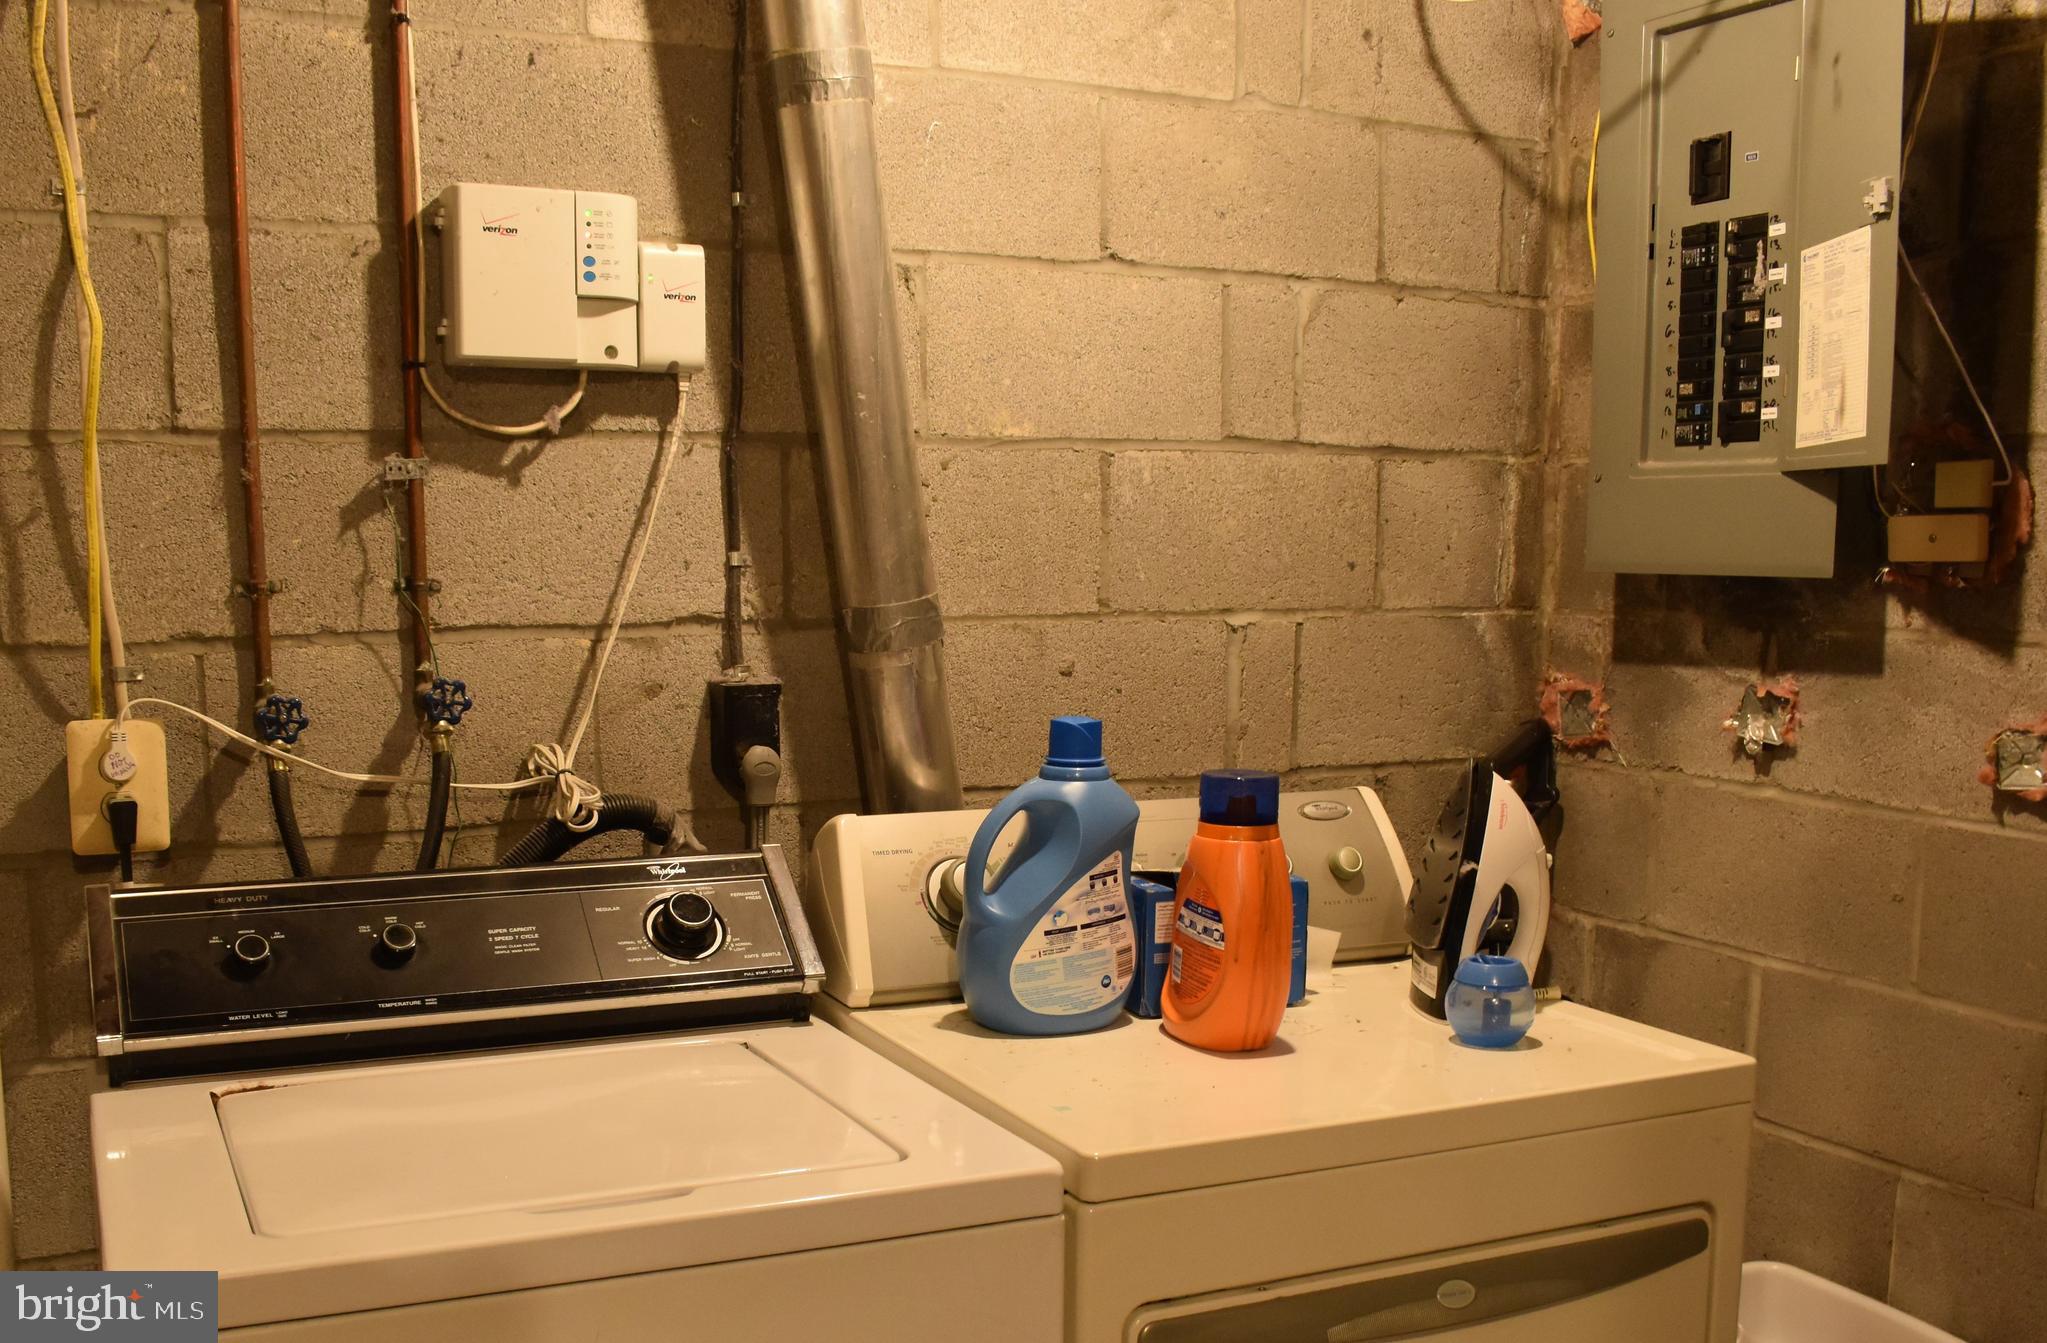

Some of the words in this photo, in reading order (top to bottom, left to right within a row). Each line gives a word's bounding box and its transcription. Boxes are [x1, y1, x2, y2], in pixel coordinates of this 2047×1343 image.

[482, 224, 520, 237] verizon
[663, 292, 698, 303] verizon
[892, 848, 913, 856] DRYING
[378, 999, 422, 1008] TEMPERATURE
